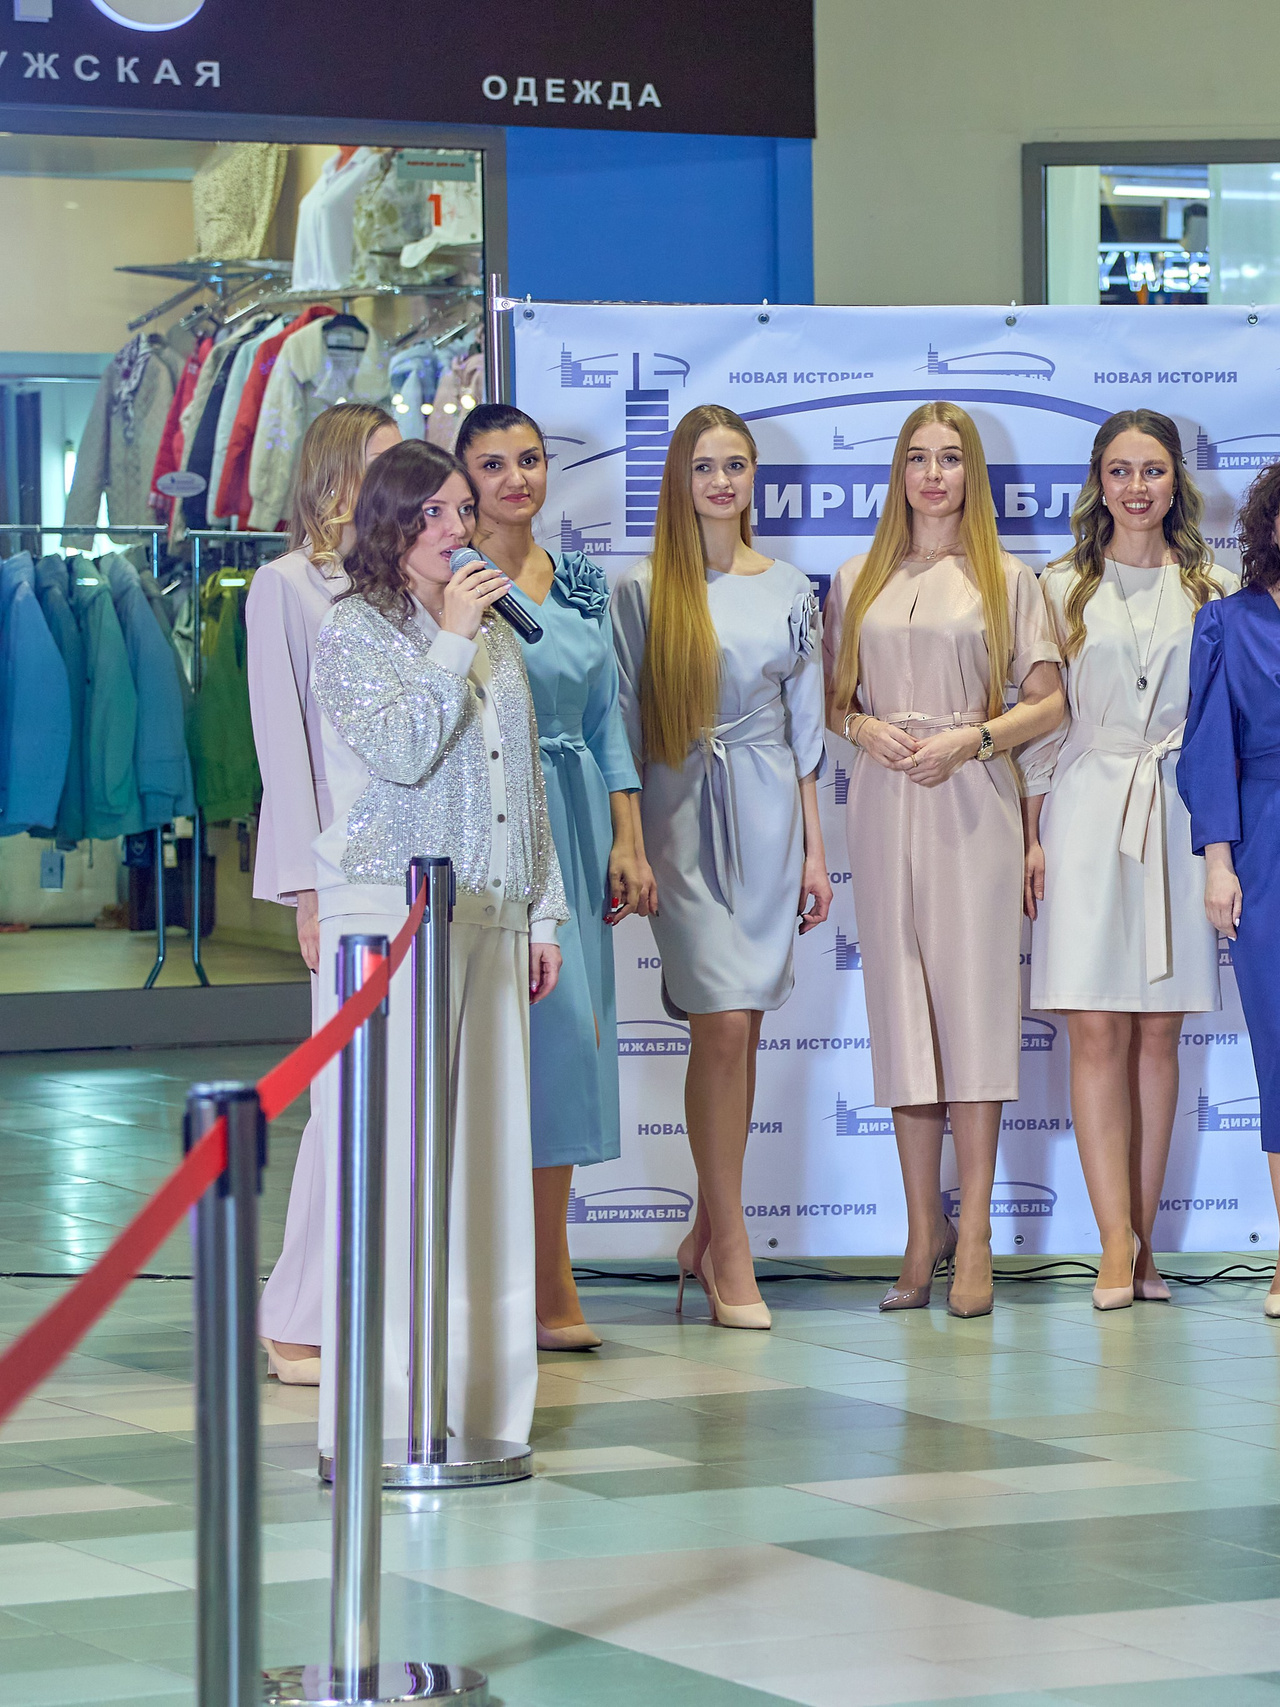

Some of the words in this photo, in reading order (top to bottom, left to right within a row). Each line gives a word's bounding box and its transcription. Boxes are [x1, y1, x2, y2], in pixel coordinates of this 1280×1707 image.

[482, 75, 662, 111] ОДЕЖДА
[427, 194, 442, 226] 1
[729, 371, 788, 384] НОВАЯ
[1094, 372, 1152, 384] НОВАЯ
[1157, 371, 1238, 384] ИСТОРИЯ
[757, 1039, 791, 1051] ВАЯ
[1178, 1034, 1238, 1046] ТОРИЯ
[619, 1041, 687, 1053] ИЖАБЛЬ
[638, 1123, 688, 1136] НОВА
[1002, 1118, 1060, 1131] НОВАЯ
[743, 1204, 791, 1217] ОВАЯ
[796, 1203, 877, 1216] ИСТОРИЯ
[1159, 1198, 1239, 1210] ИСТОРИЯ
[586, 1207, 687, 1222] ДИРИЖАБЛЬ
